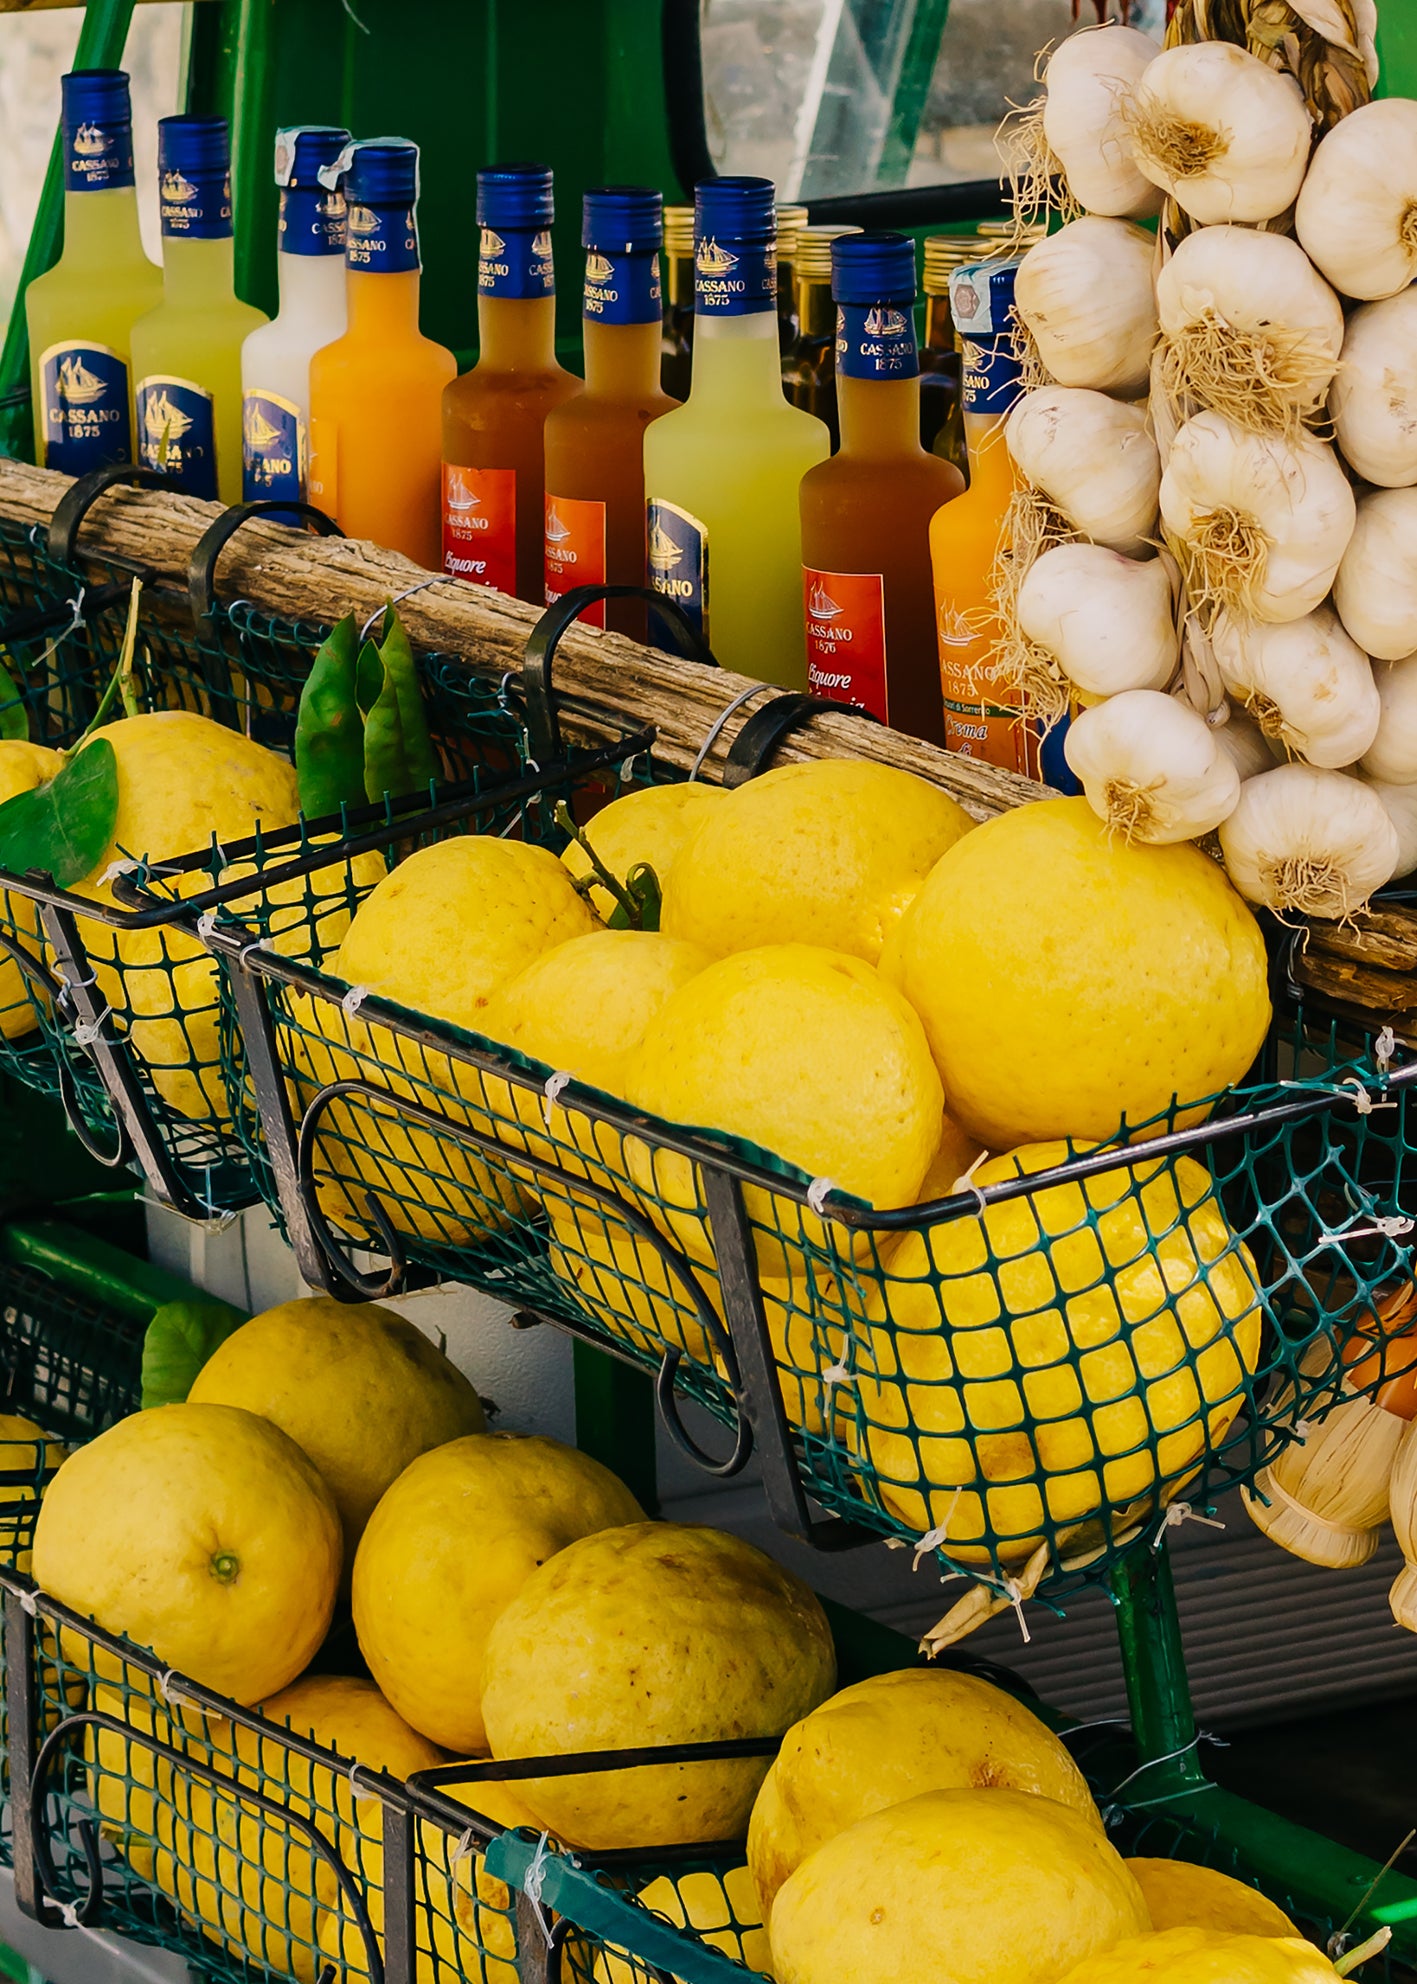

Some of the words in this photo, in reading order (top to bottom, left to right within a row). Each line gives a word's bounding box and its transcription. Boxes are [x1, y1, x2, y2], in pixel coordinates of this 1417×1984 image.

[695, 279, 745, 292] CASSANO
[704, 293, 730, 306] 1875
[875, 358, 903, 371] 1875
[50, 408, 120, 424] CASSANO
[69, 425, 100, 438] 1875
[452, 528, 473, 542] 1875
[444, 550, 487, 576] Liquore
[942, 658, 996, 682] ASSANO
[948, 680, 975, 698] 1875
[945, 714, 988, 740] Crema
